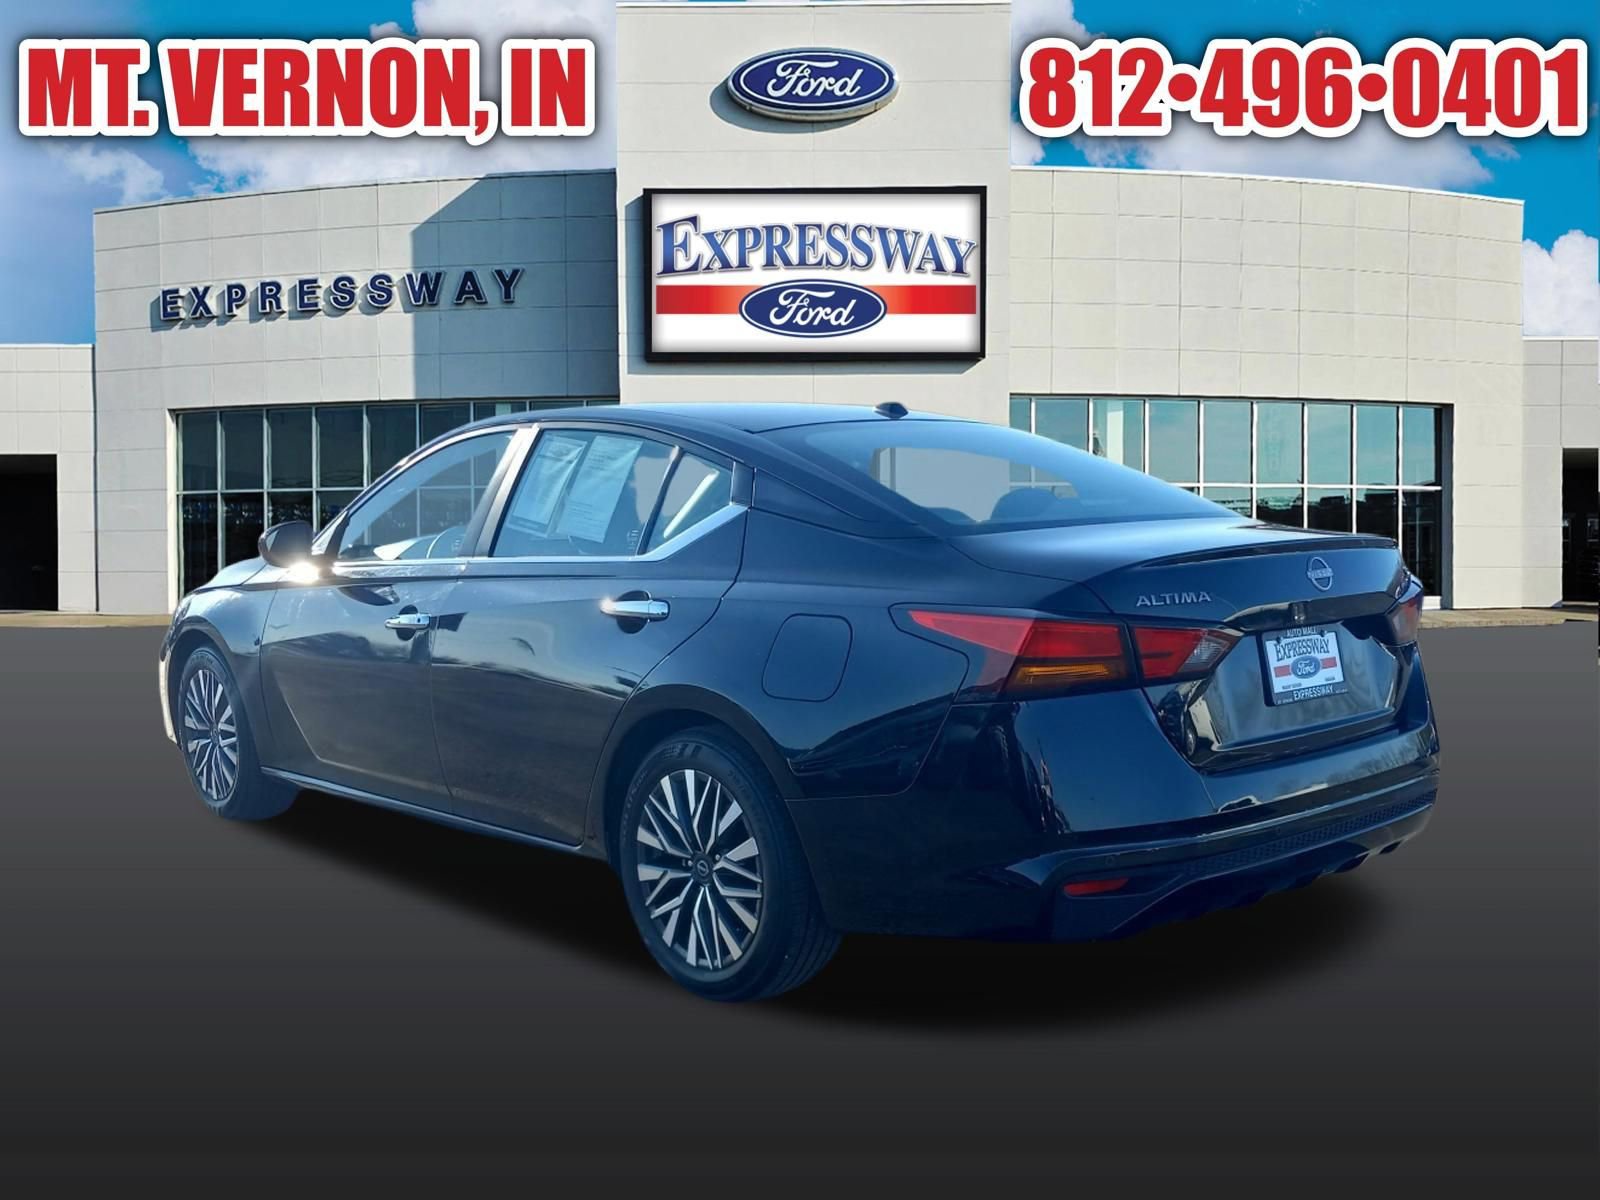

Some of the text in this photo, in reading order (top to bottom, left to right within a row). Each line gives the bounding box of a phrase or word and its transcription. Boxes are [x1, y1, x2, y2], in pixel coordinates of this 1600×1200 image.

[767, 60, 862, 97] Ford
[159, 268, 525, 320] EXPRESSWAY
[769, 289, 856, 326] Ford
[1136, 591, 1212, 607] ALTIMA
[1274, 639, 1330, 662] EXPRESSWAY
[1297, 660, 1316, 675] Ford
[1293, 685, 1334, 701] EXPRESSWAY
